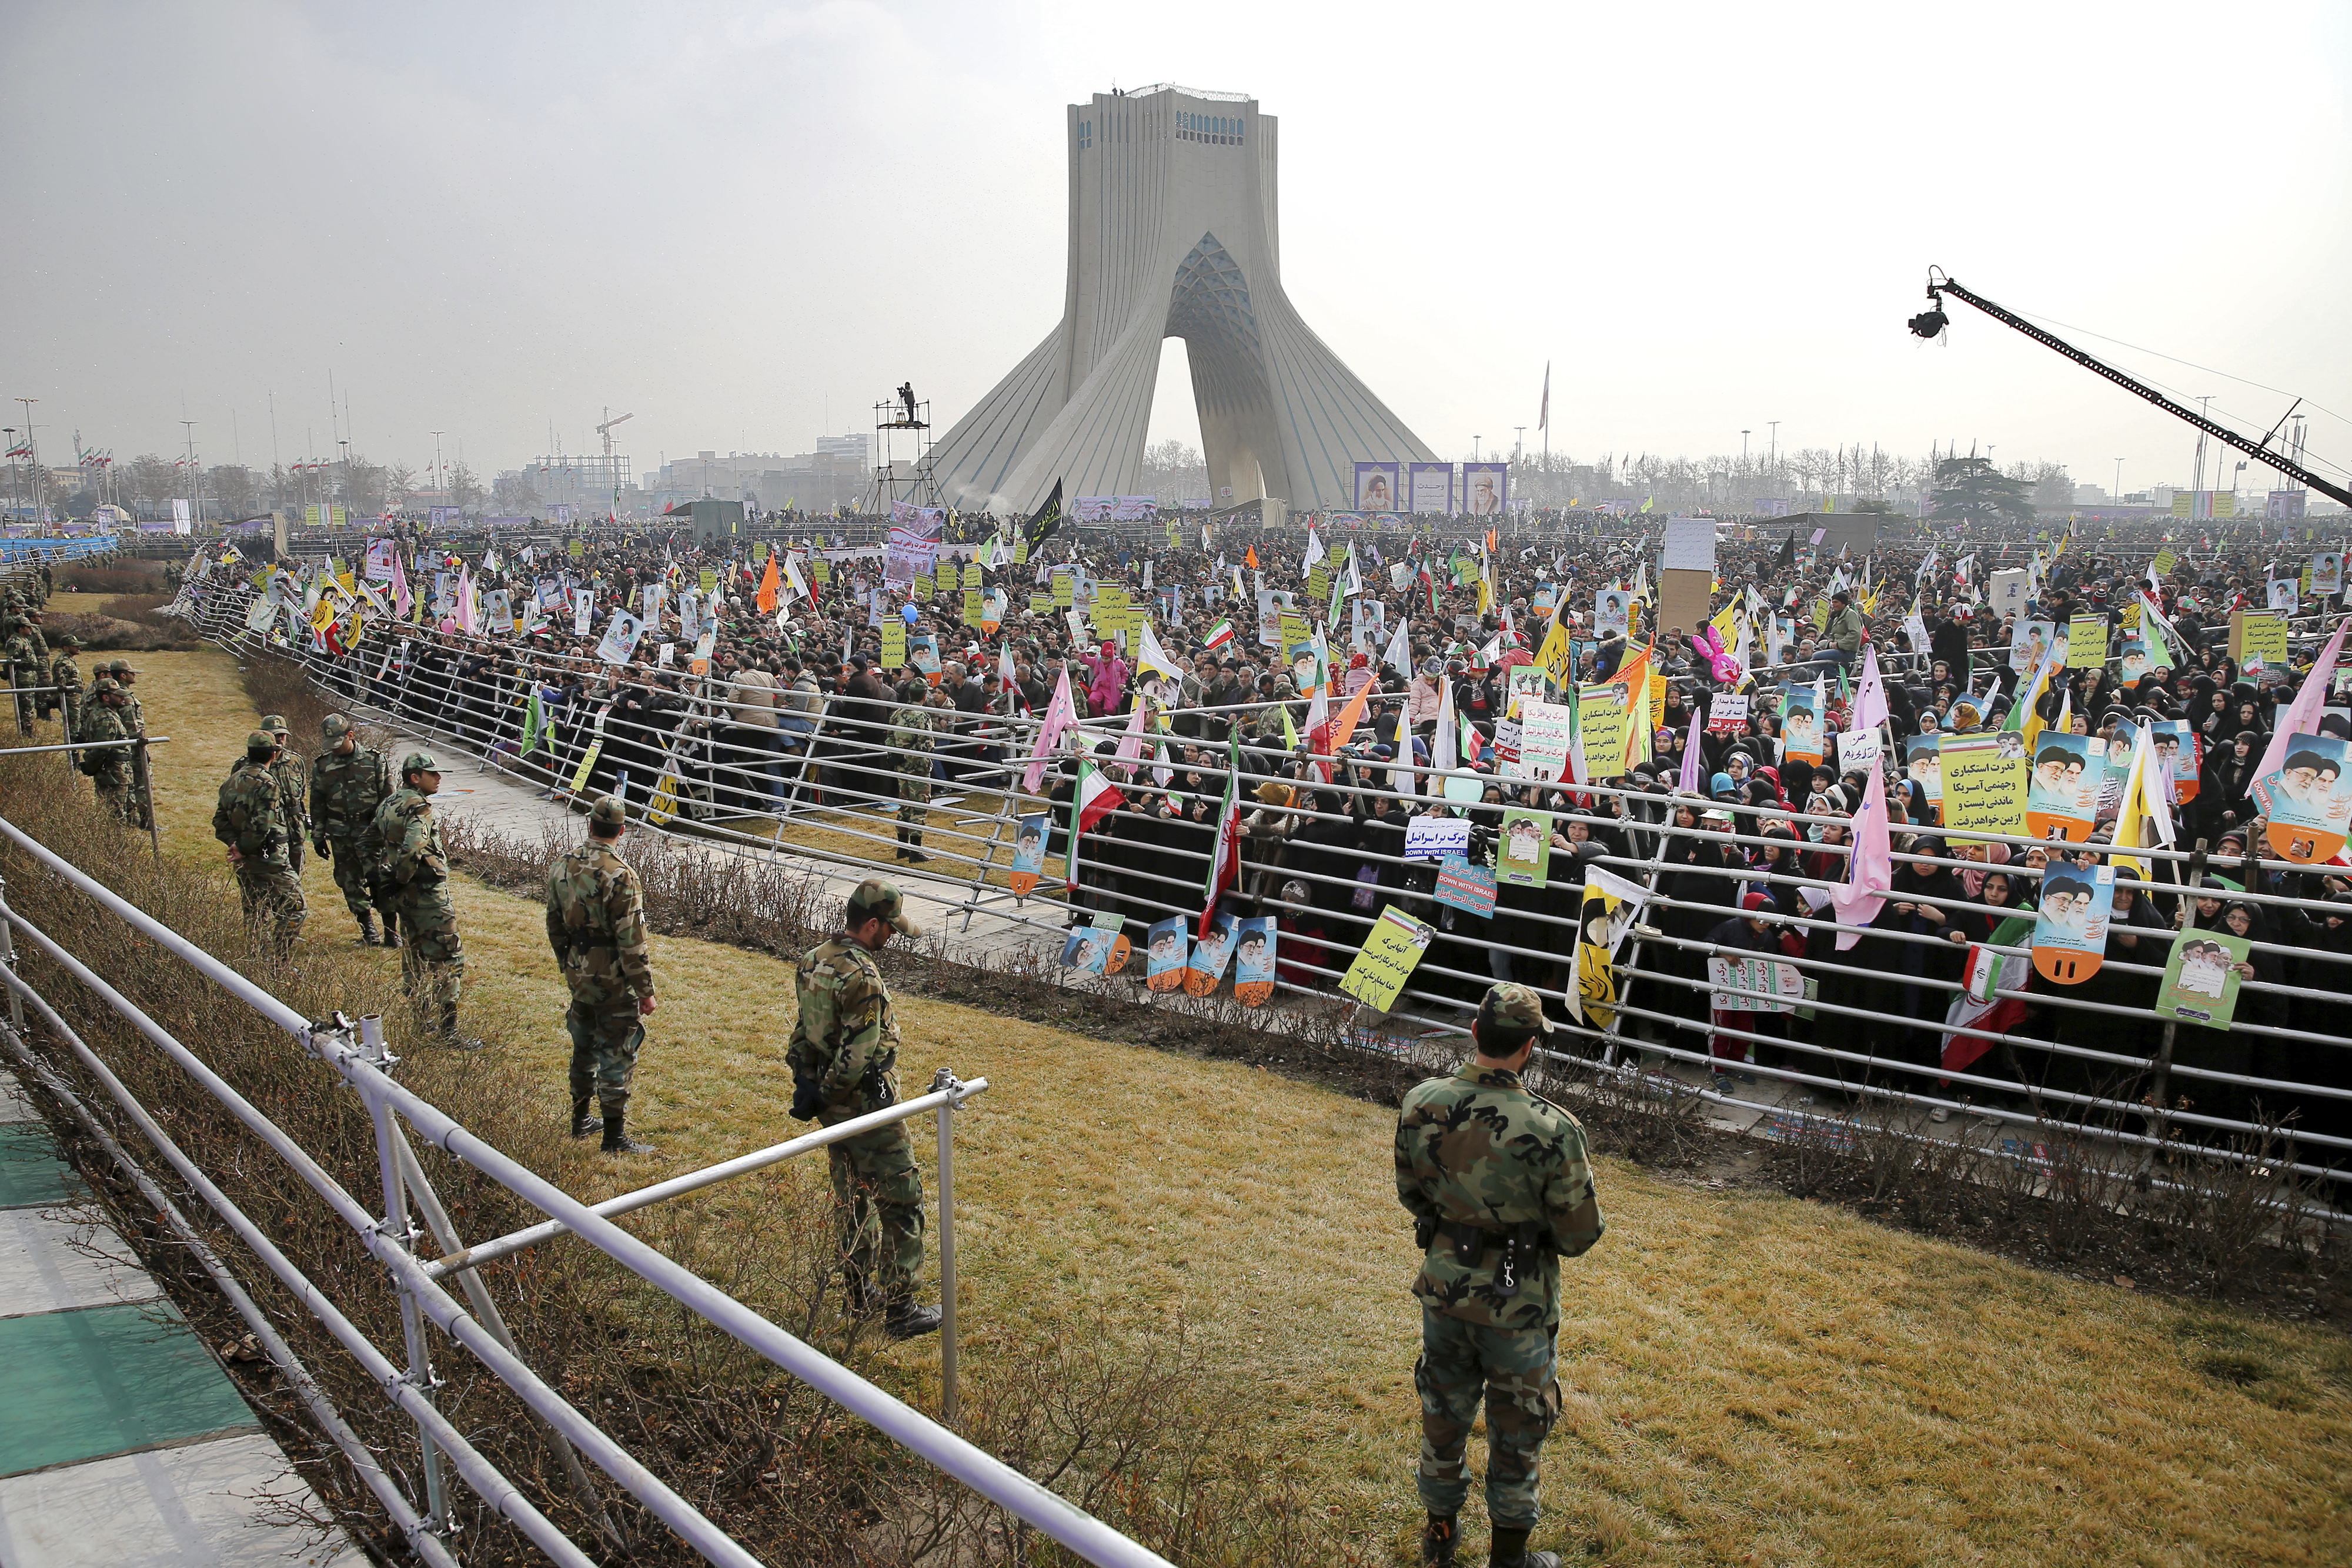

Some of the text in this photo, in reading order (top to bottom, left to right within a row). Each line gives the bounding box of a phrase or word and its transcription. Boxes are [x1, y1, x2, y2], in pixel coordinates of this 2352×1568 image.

[1545, 713, 1551, 721] بر
[1552, 709, 1564, 720] مرگ
[1582, 707, 1622, 721] قدرت استکباری
[1583, 723, 1601, 735] آمریکا
[1730, 721, 1745, 731] مرگ
[1526, 728, 1545, 737] اسرائیل
[1552, 730, 1563, 739] مرگ
[1599, 737, 1616, 747] ماندنی
[1850, 734, 1866, 745] من
[1524, 745, 1544, 754] انگلیس
[1552, 748, 1563, 757] مرگ
[1504, 751, 1520, 760] فتنه
[1950, 760, 2016, 777] قدرت استکباری
[2254, 781, 2269, 802] DOWN
[1958, 796, 2013, 811] ماندنی نیست و
[1407, 831, 1465, 844] مرگ بر اسرائیل
[1442, 858, 1496, 885] مرگ بر اسرائیل
[1439, 875, 1495, 898] DOWN WITH ISRAEL
[1436, 887, 1492, 912] الموت لاسرائیل
[1387, 944, 1409, 954] آنهایی
[1396, 966, 1409, 975] خواب
[1718, 963, 1726, 976] مرگ
[1737, 962, 1746, 975] مرگ
[1757, 962, 1766, 975] مرگ
[1385, 981, 1395, 991] خدا
